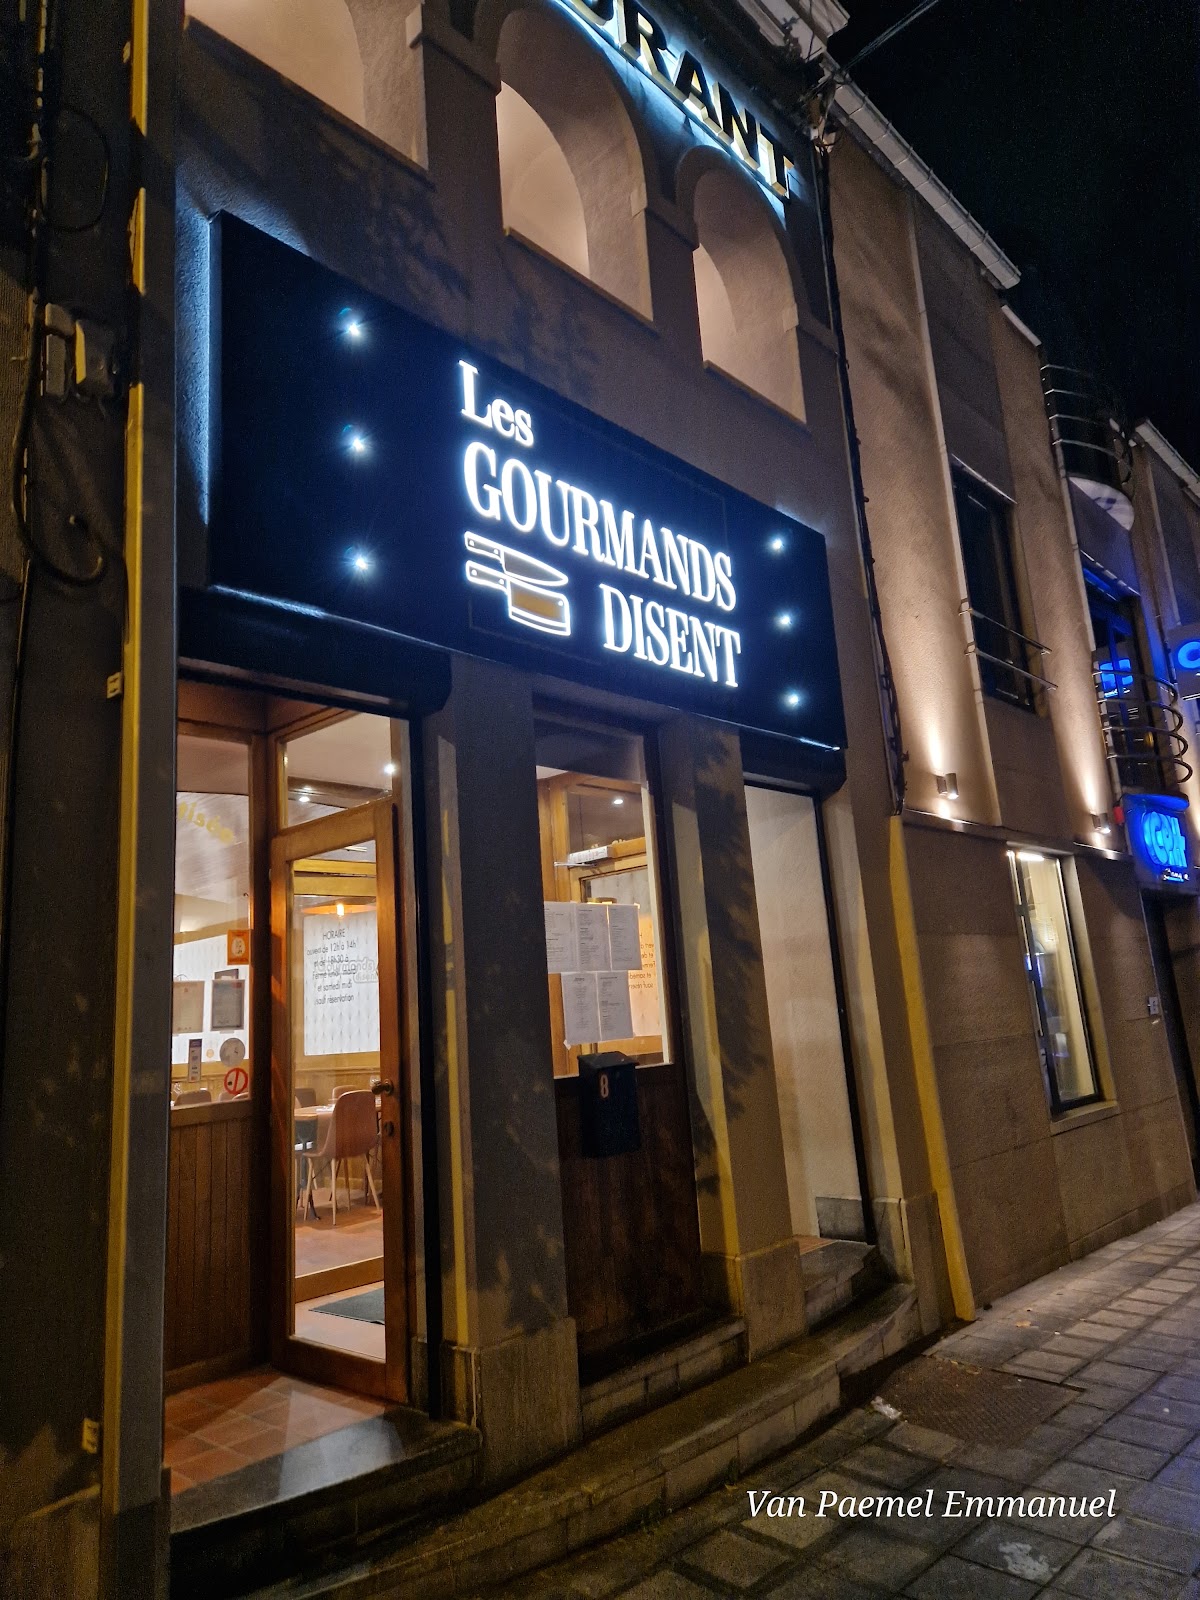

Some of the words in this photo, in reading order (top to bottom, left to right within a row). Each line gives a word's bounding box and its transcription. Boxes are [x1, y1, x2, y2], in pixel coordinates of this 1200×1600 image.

[459, 359, 534, 447] Les
[464, 441, 737, 612] GOURMANDS
[599, 583, 742, 688] DISENT
[600, 1074, 609, 1098] 8
